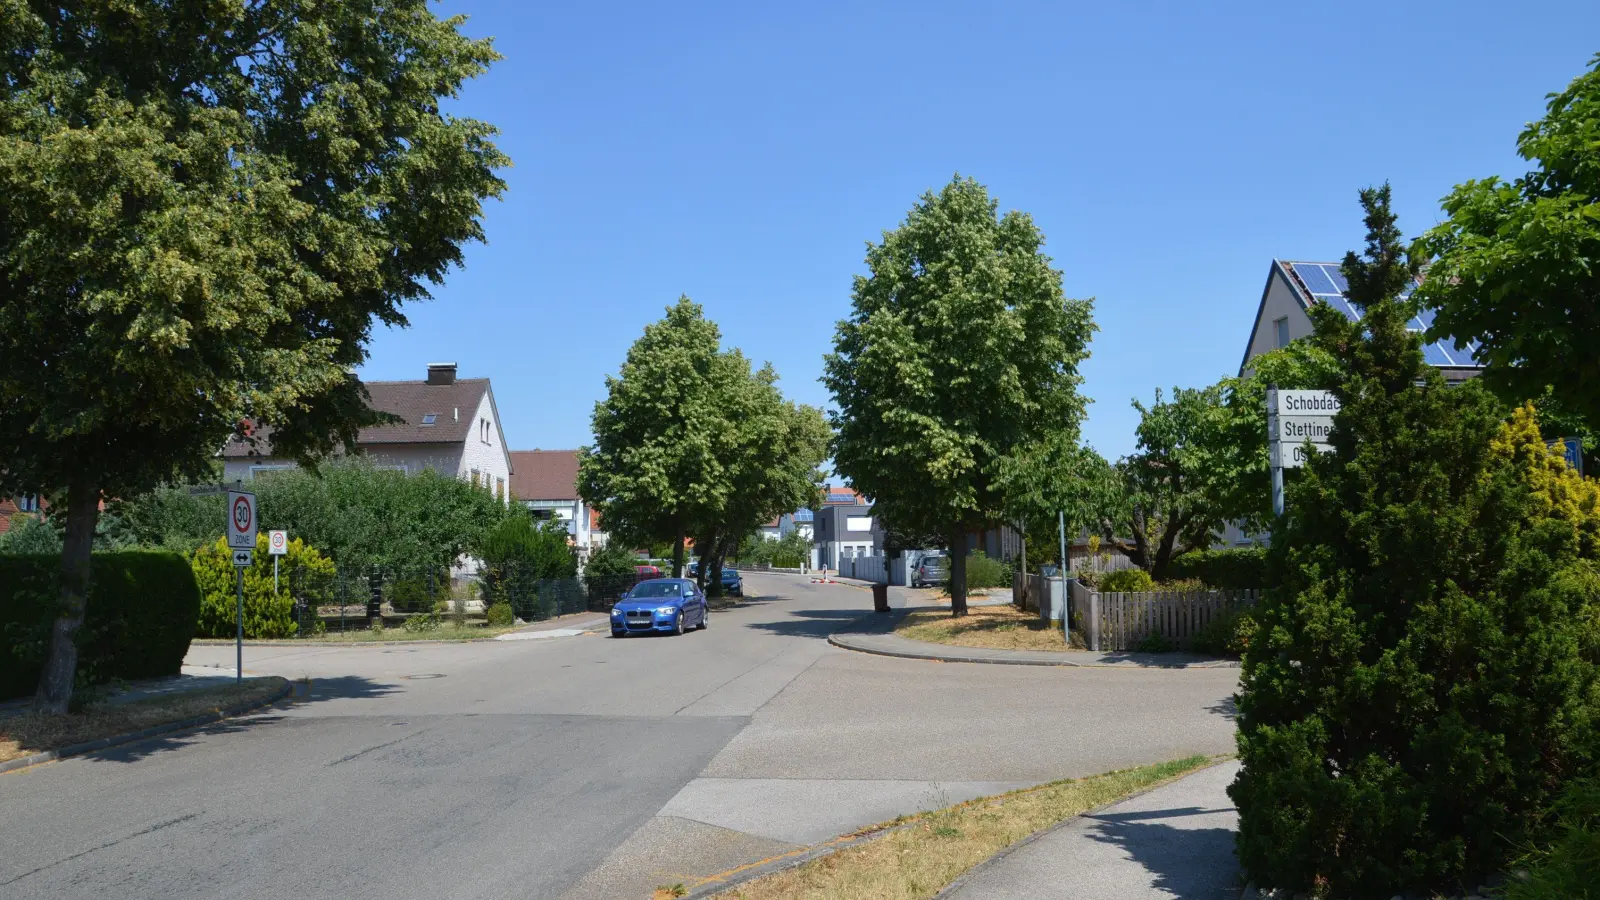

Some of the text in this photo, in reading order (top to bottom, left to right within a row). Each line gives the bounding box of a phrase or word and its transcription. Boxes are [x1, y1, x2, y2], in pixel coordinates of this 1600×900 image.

[1286, 395, 1340, 410] Schobdac
[237, 506, 248, 523] 30
[235, 534, 250, 545] ZONE
